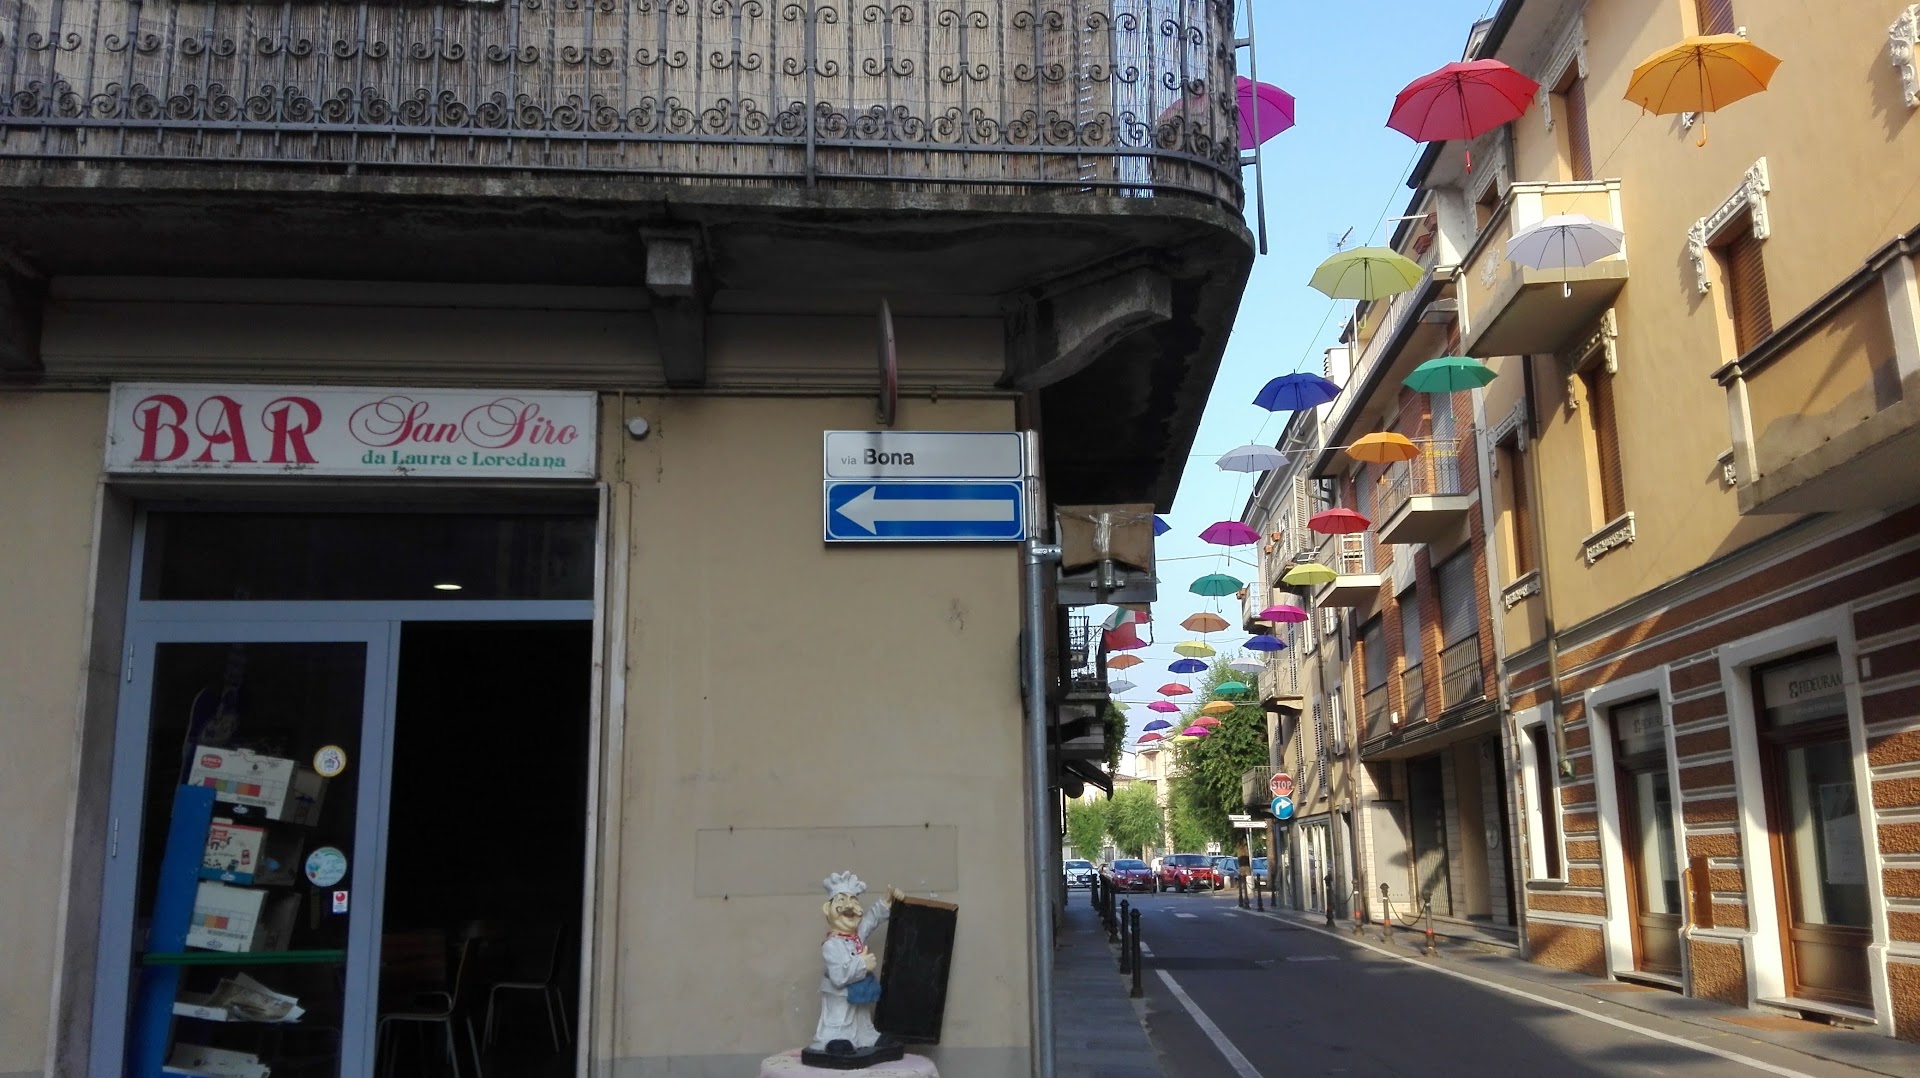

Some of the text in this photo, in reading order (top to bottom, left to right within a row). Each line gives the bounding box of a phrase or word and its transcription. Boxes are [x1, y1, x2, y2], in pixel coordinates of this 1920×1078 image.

[133, 394, 578, 464] BAR San Siro
[361, 450, 567, 469] da Laura e Loredana
[841, 448, 915, 465] via Bona
[1271, 780, 1292, 790] STOP
